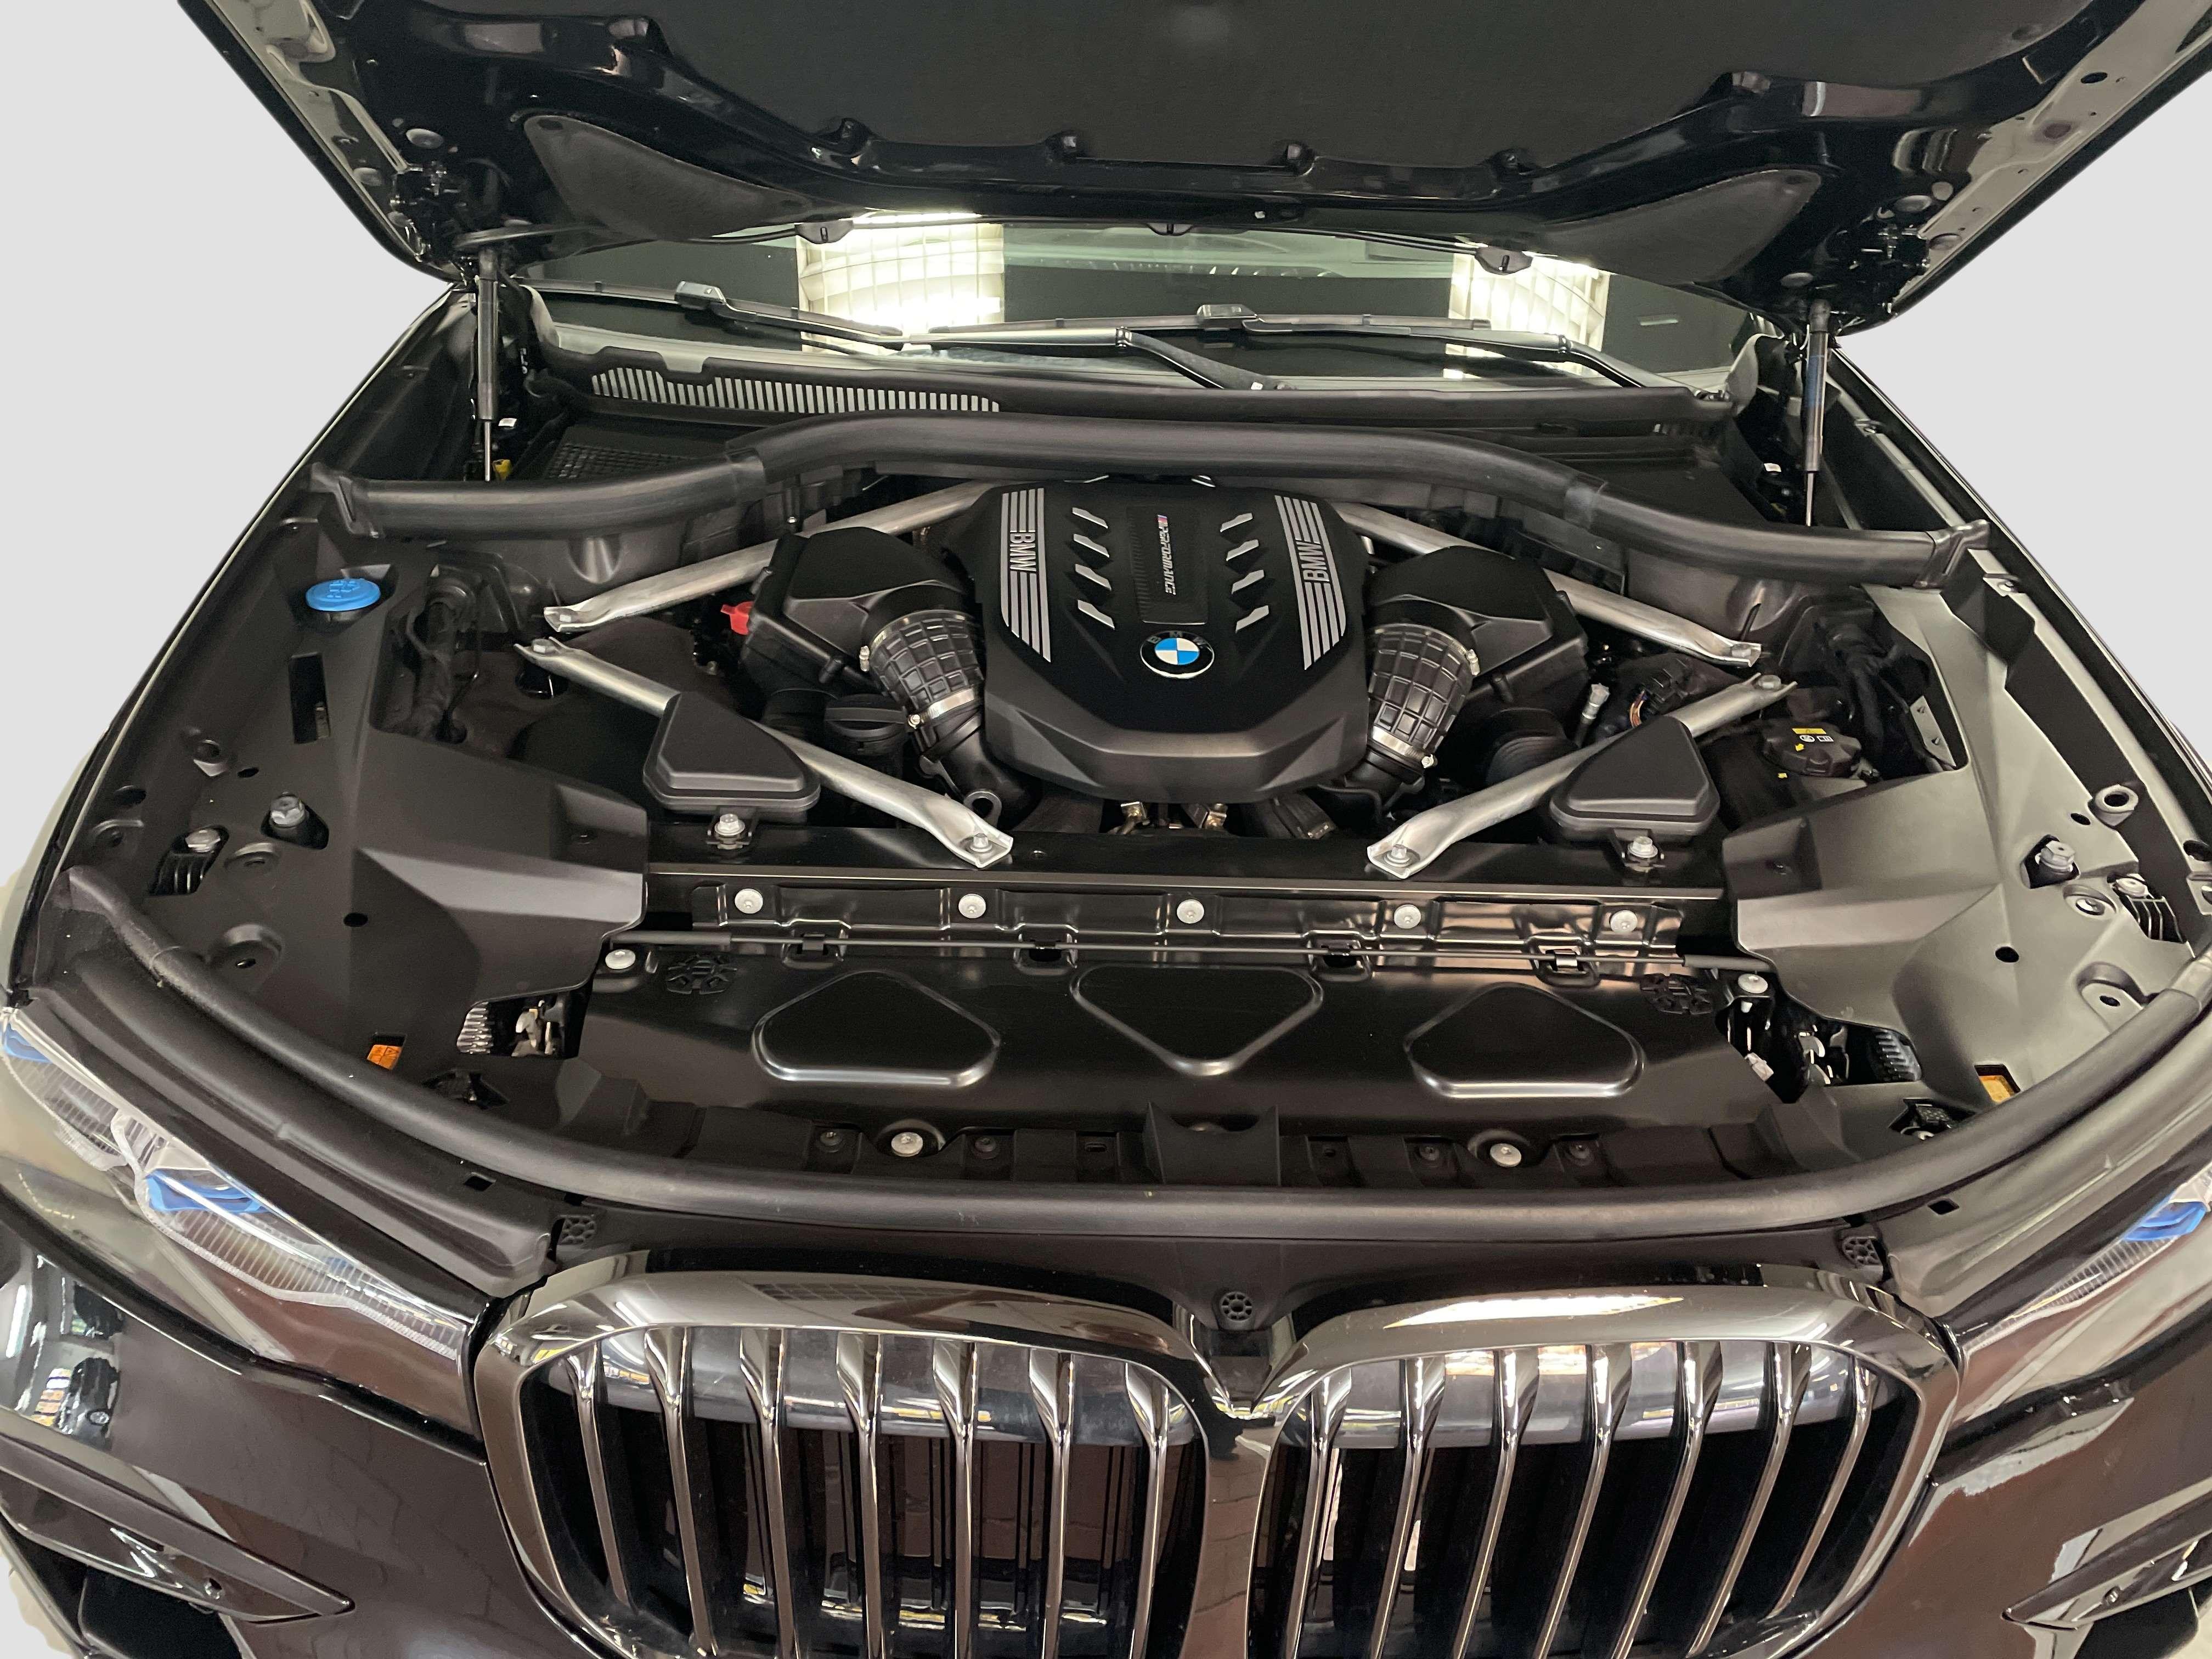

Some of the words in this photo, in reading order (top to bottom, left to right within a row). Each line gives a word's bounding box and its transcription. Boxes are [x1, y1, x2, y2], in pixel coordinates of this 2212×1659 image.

[1009, 532, 1036, 572] BMW
[1158, 525, 1176, 595] PERFORMANCE
[1296, 541, 1330, 582] BMW
[1146, 630, 1207, 646] BMW
